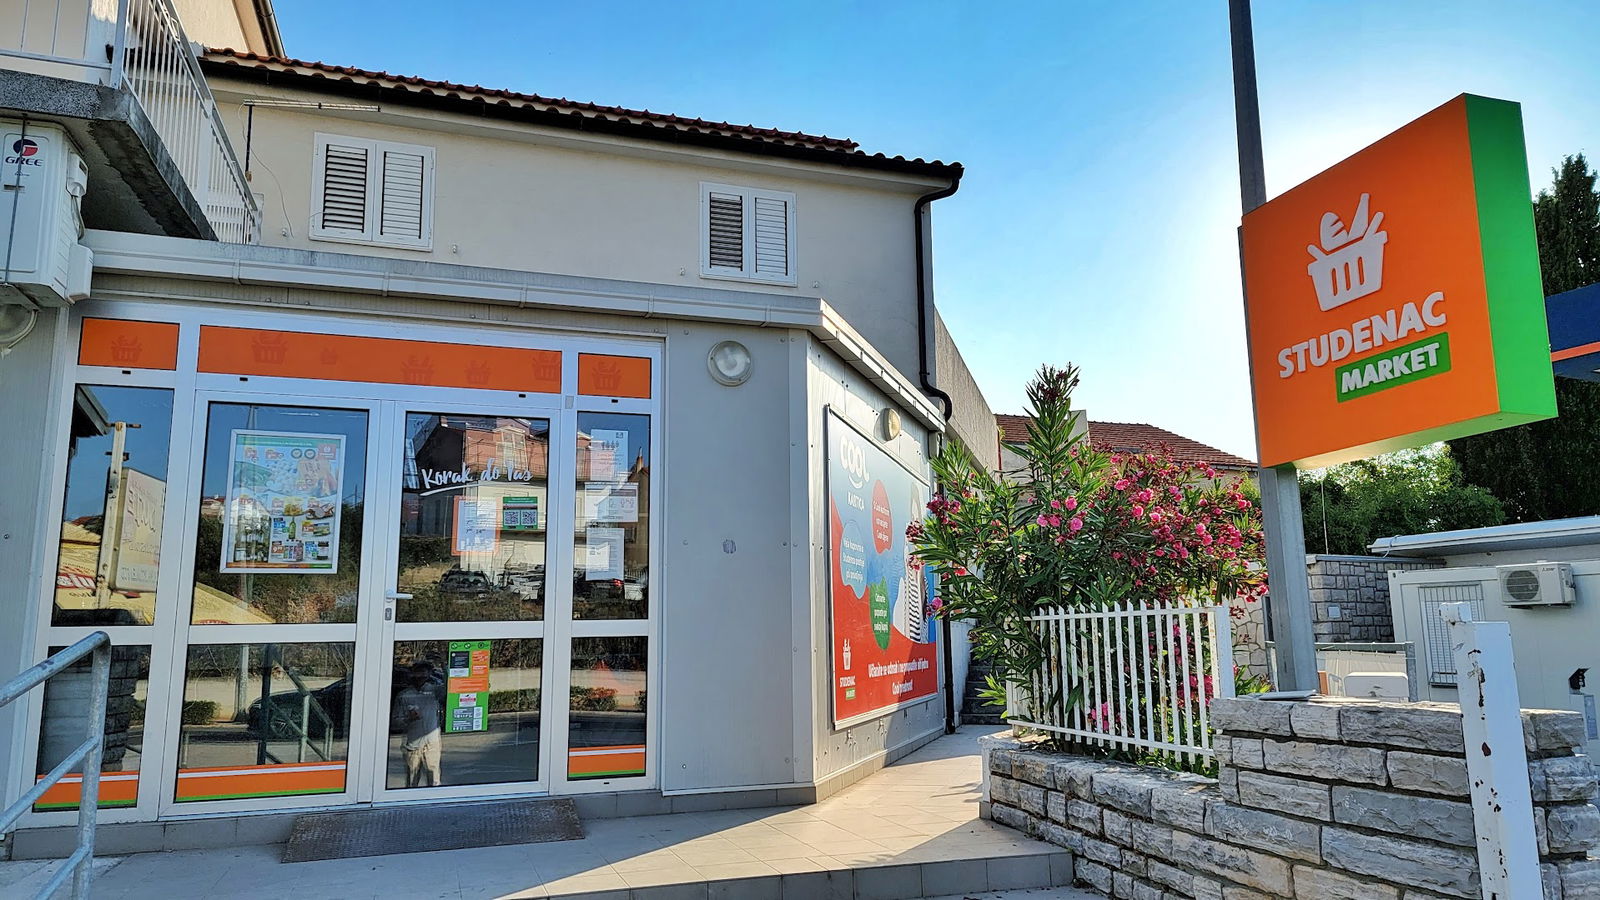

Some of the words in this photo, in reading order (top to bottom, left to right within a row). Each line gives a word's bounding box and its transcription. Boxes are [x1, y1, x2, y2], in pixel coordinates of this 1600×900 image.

[5, 156, 43, 166] GREE
[1278, 291, 1447, 378] STUDENAC
[1341, 342, 1440, 393] MARKET
[422, 462, 473, 489] Korak
[480, 458, 501, 481] do
[840, 435, 869, 482] COOL
